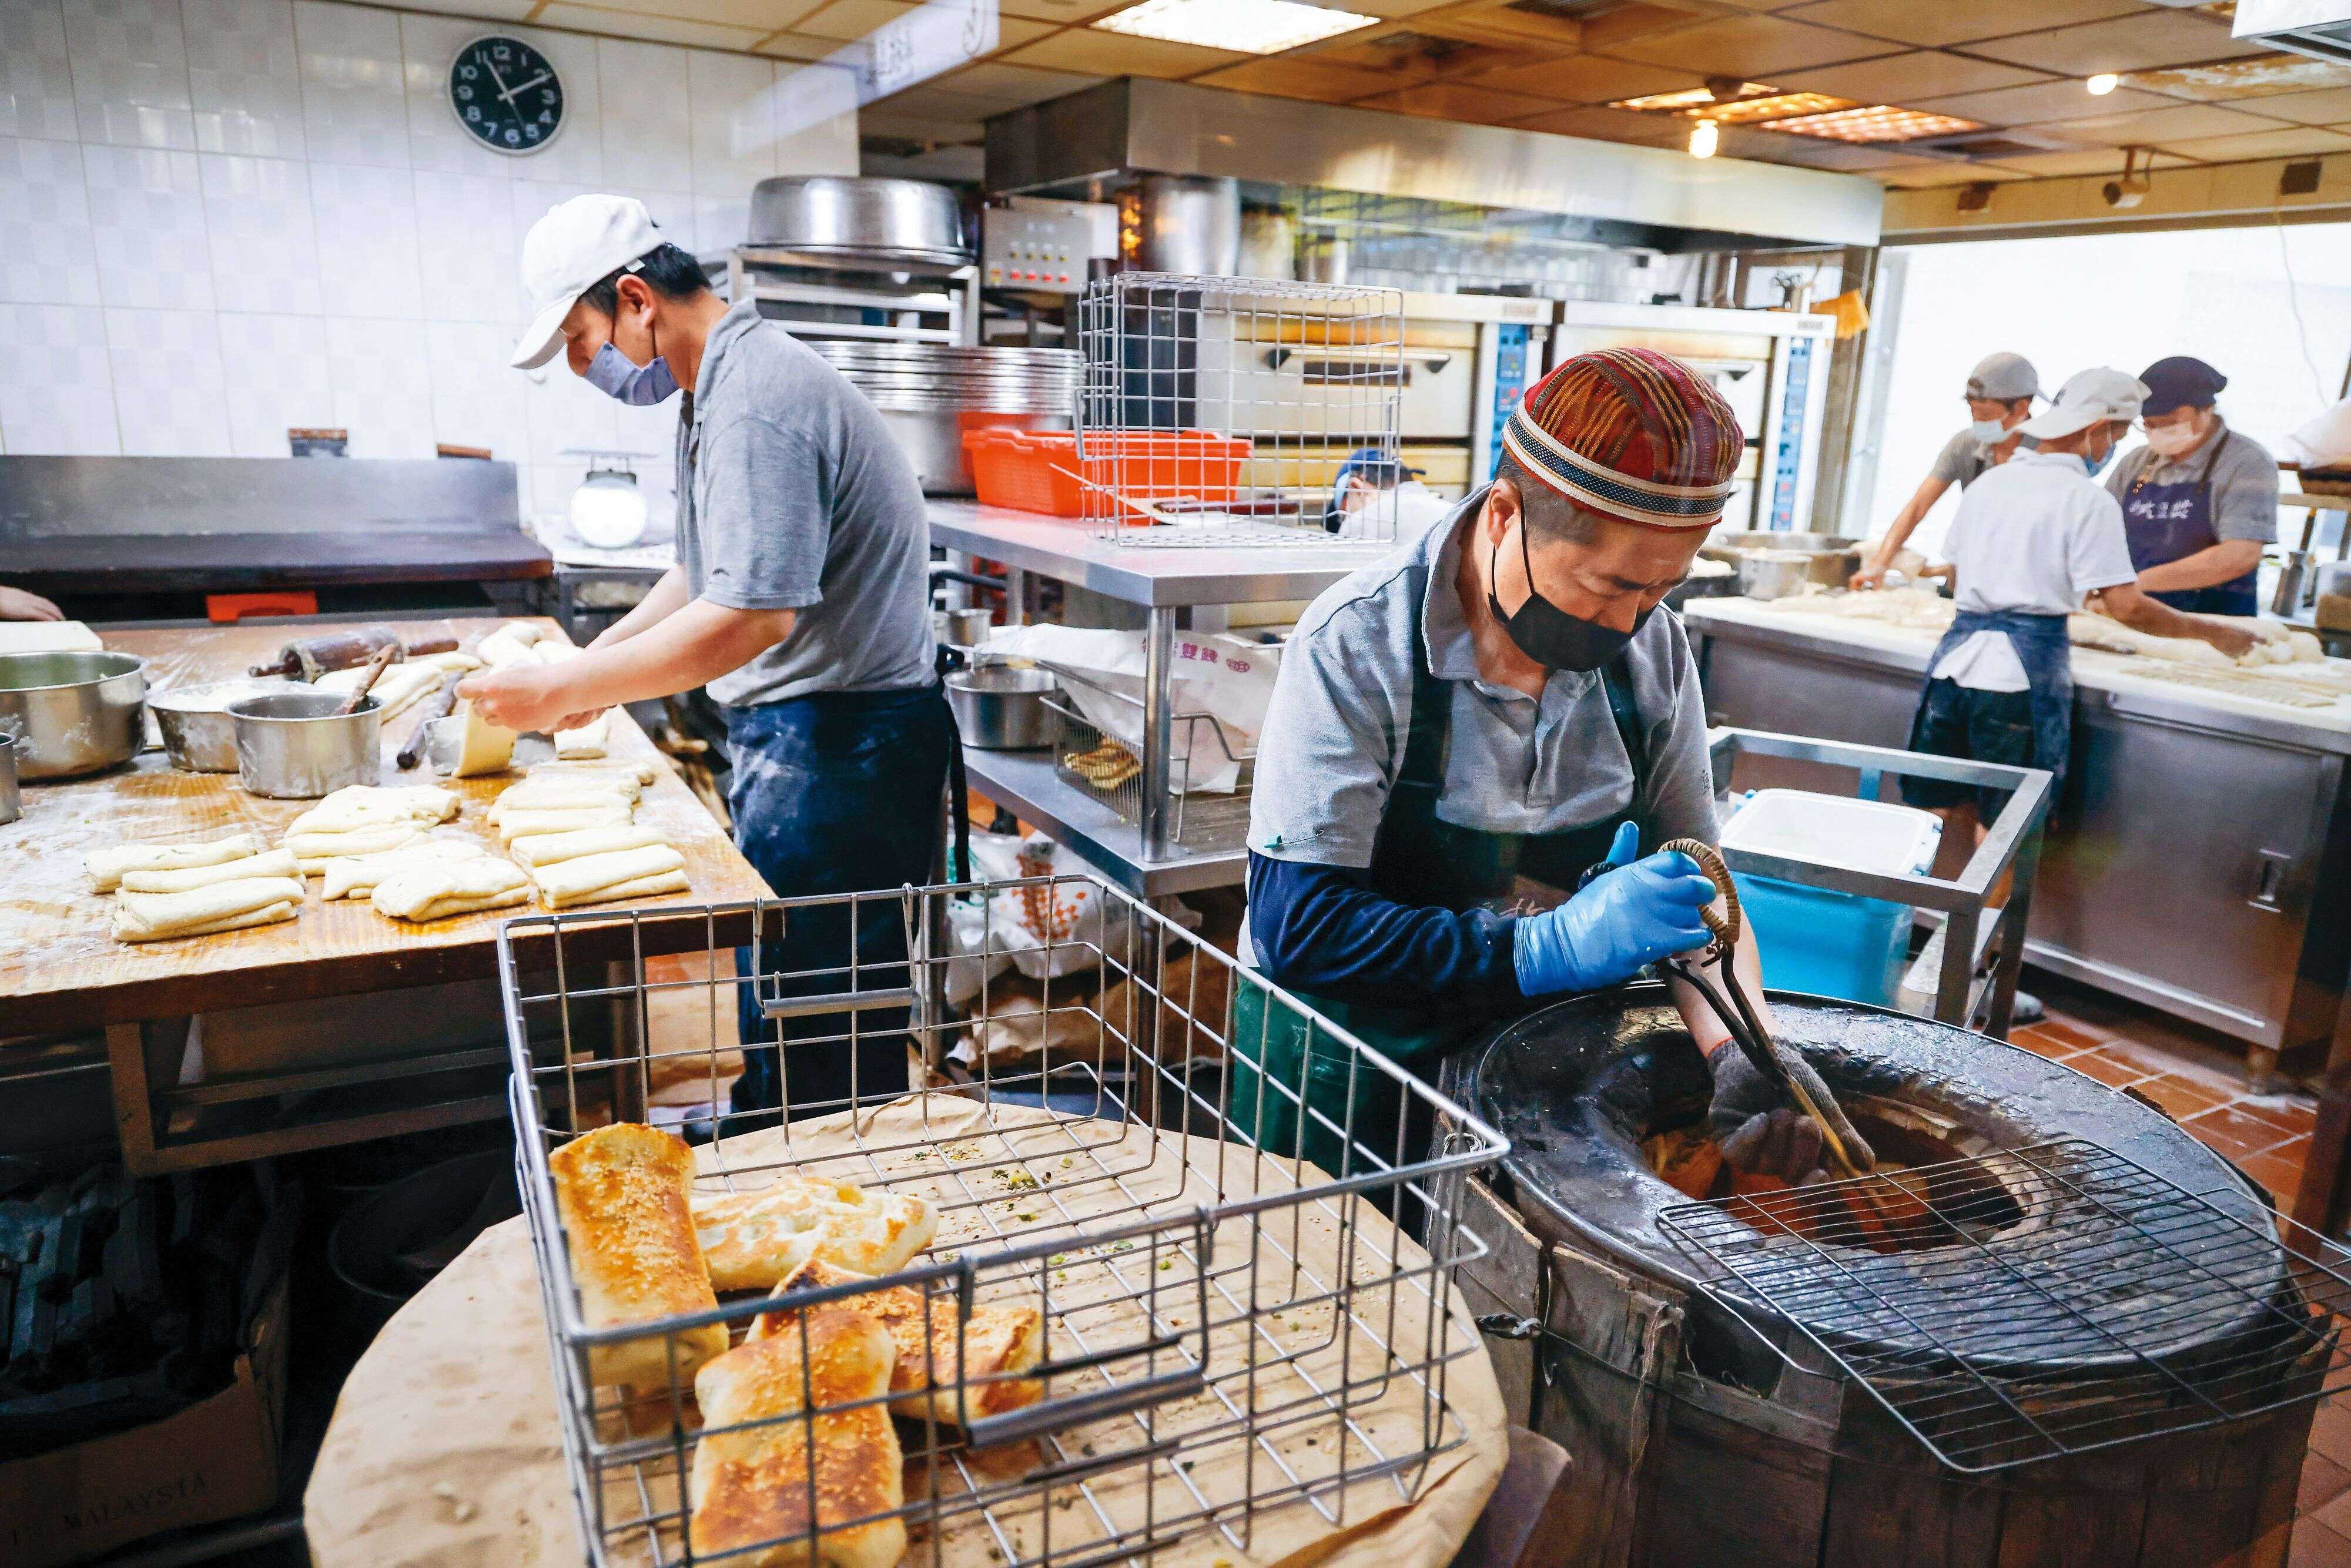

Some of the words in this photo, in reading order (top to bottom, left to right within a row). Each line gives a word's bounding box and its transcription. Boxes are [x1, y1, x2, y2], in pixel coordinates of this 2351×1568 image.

[494, 45, 511, 61] 12
[521, 52, 528, 66] 1
[458, 65, 478, 81] 10
[457, 85, 474, 100] 9
[541, 89, 556, 105] 3
[467, 106, 482, 122] 8
[538, 108, 552, 123] 4
[483, 121, 498, 137] 7
[504, 128, 521, 145] 6
[525, 123, 540, 139] 5
[62, 1469, 206, 1530] MALAYSIA
